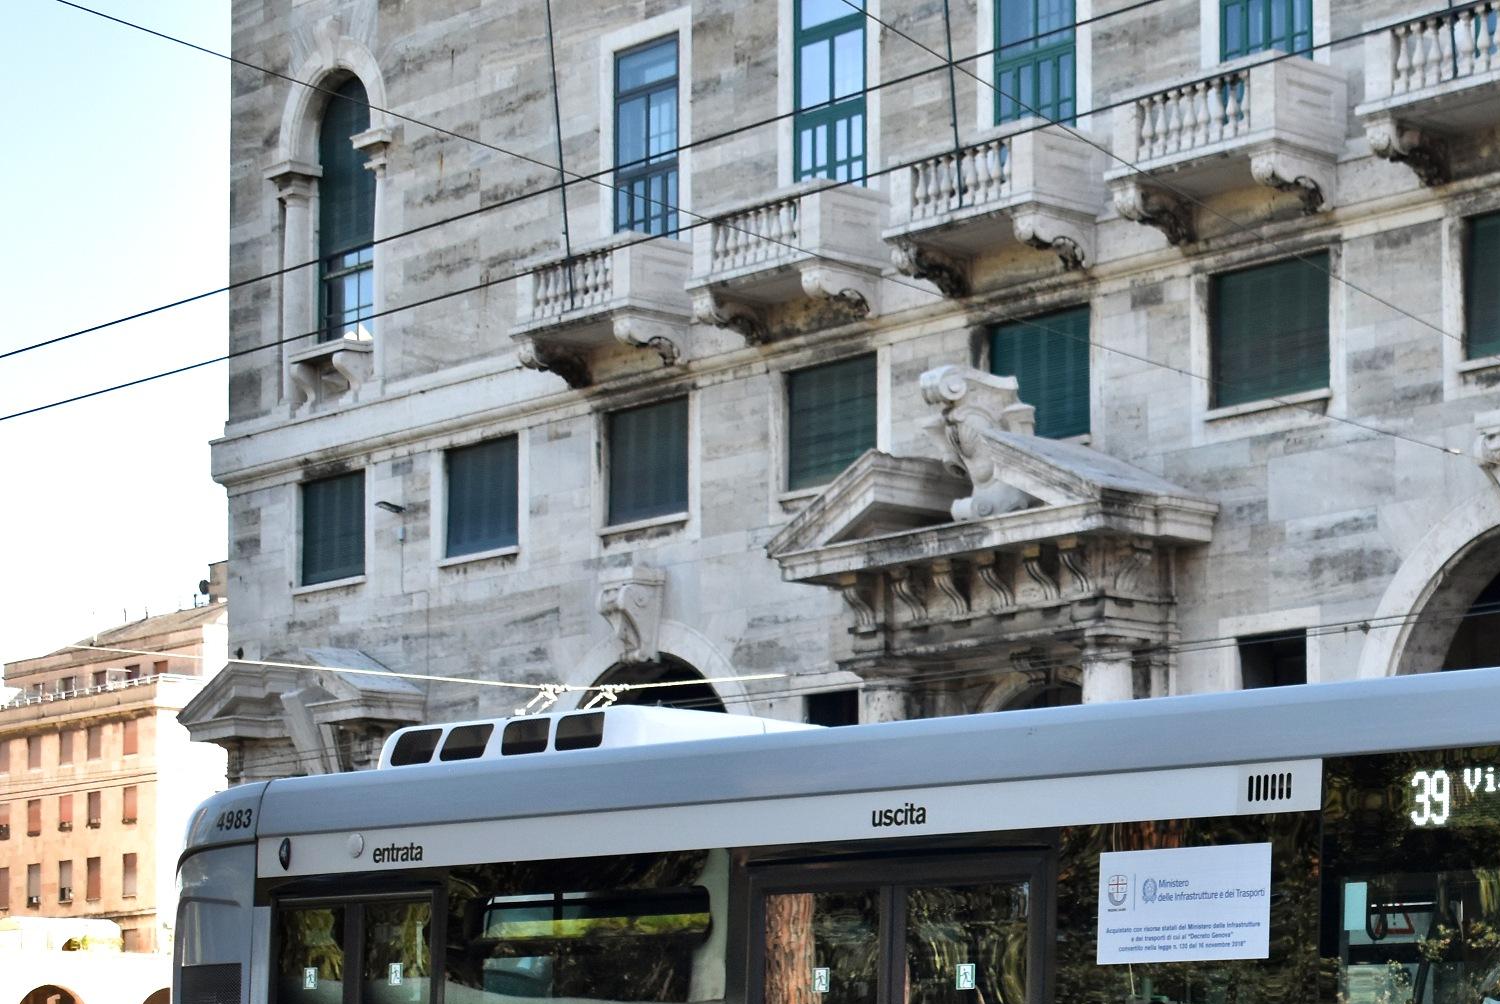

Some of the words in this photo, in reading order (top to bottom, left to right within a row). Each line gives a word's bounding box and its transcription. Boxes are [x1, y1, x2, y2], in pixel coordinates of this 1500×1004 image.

[1411, 769, 1450, 826] 39
[216, 808, 252, 832] 4983
[871, 802, 927, 828] uscita
[372, 842, 423, 864] entrata
[1158, 879, 1190, 888] Ministero
[1157, 892, 1174, 902] delle
[1175, 889, 1218, 901] Infrastrutture
[1219, 891, 1224, 899] e
[1225, 888, 1235, 899] dei
[1236, 887, 1265, 900] Trasporti
[1106, 927, 1132, 935] Acquistato
[1162, 924, 1177, 932] statali
[1178, 923, 1187, 931] del
[1213, 921, 1225, 929] delle
[1226, 921, 1260, 929] Infrastrutture
[1144, 934, 1166, 943] trasporti
[1118, 944, 1144, 952] convertito
[1158, 943, 1172, 952] legge
